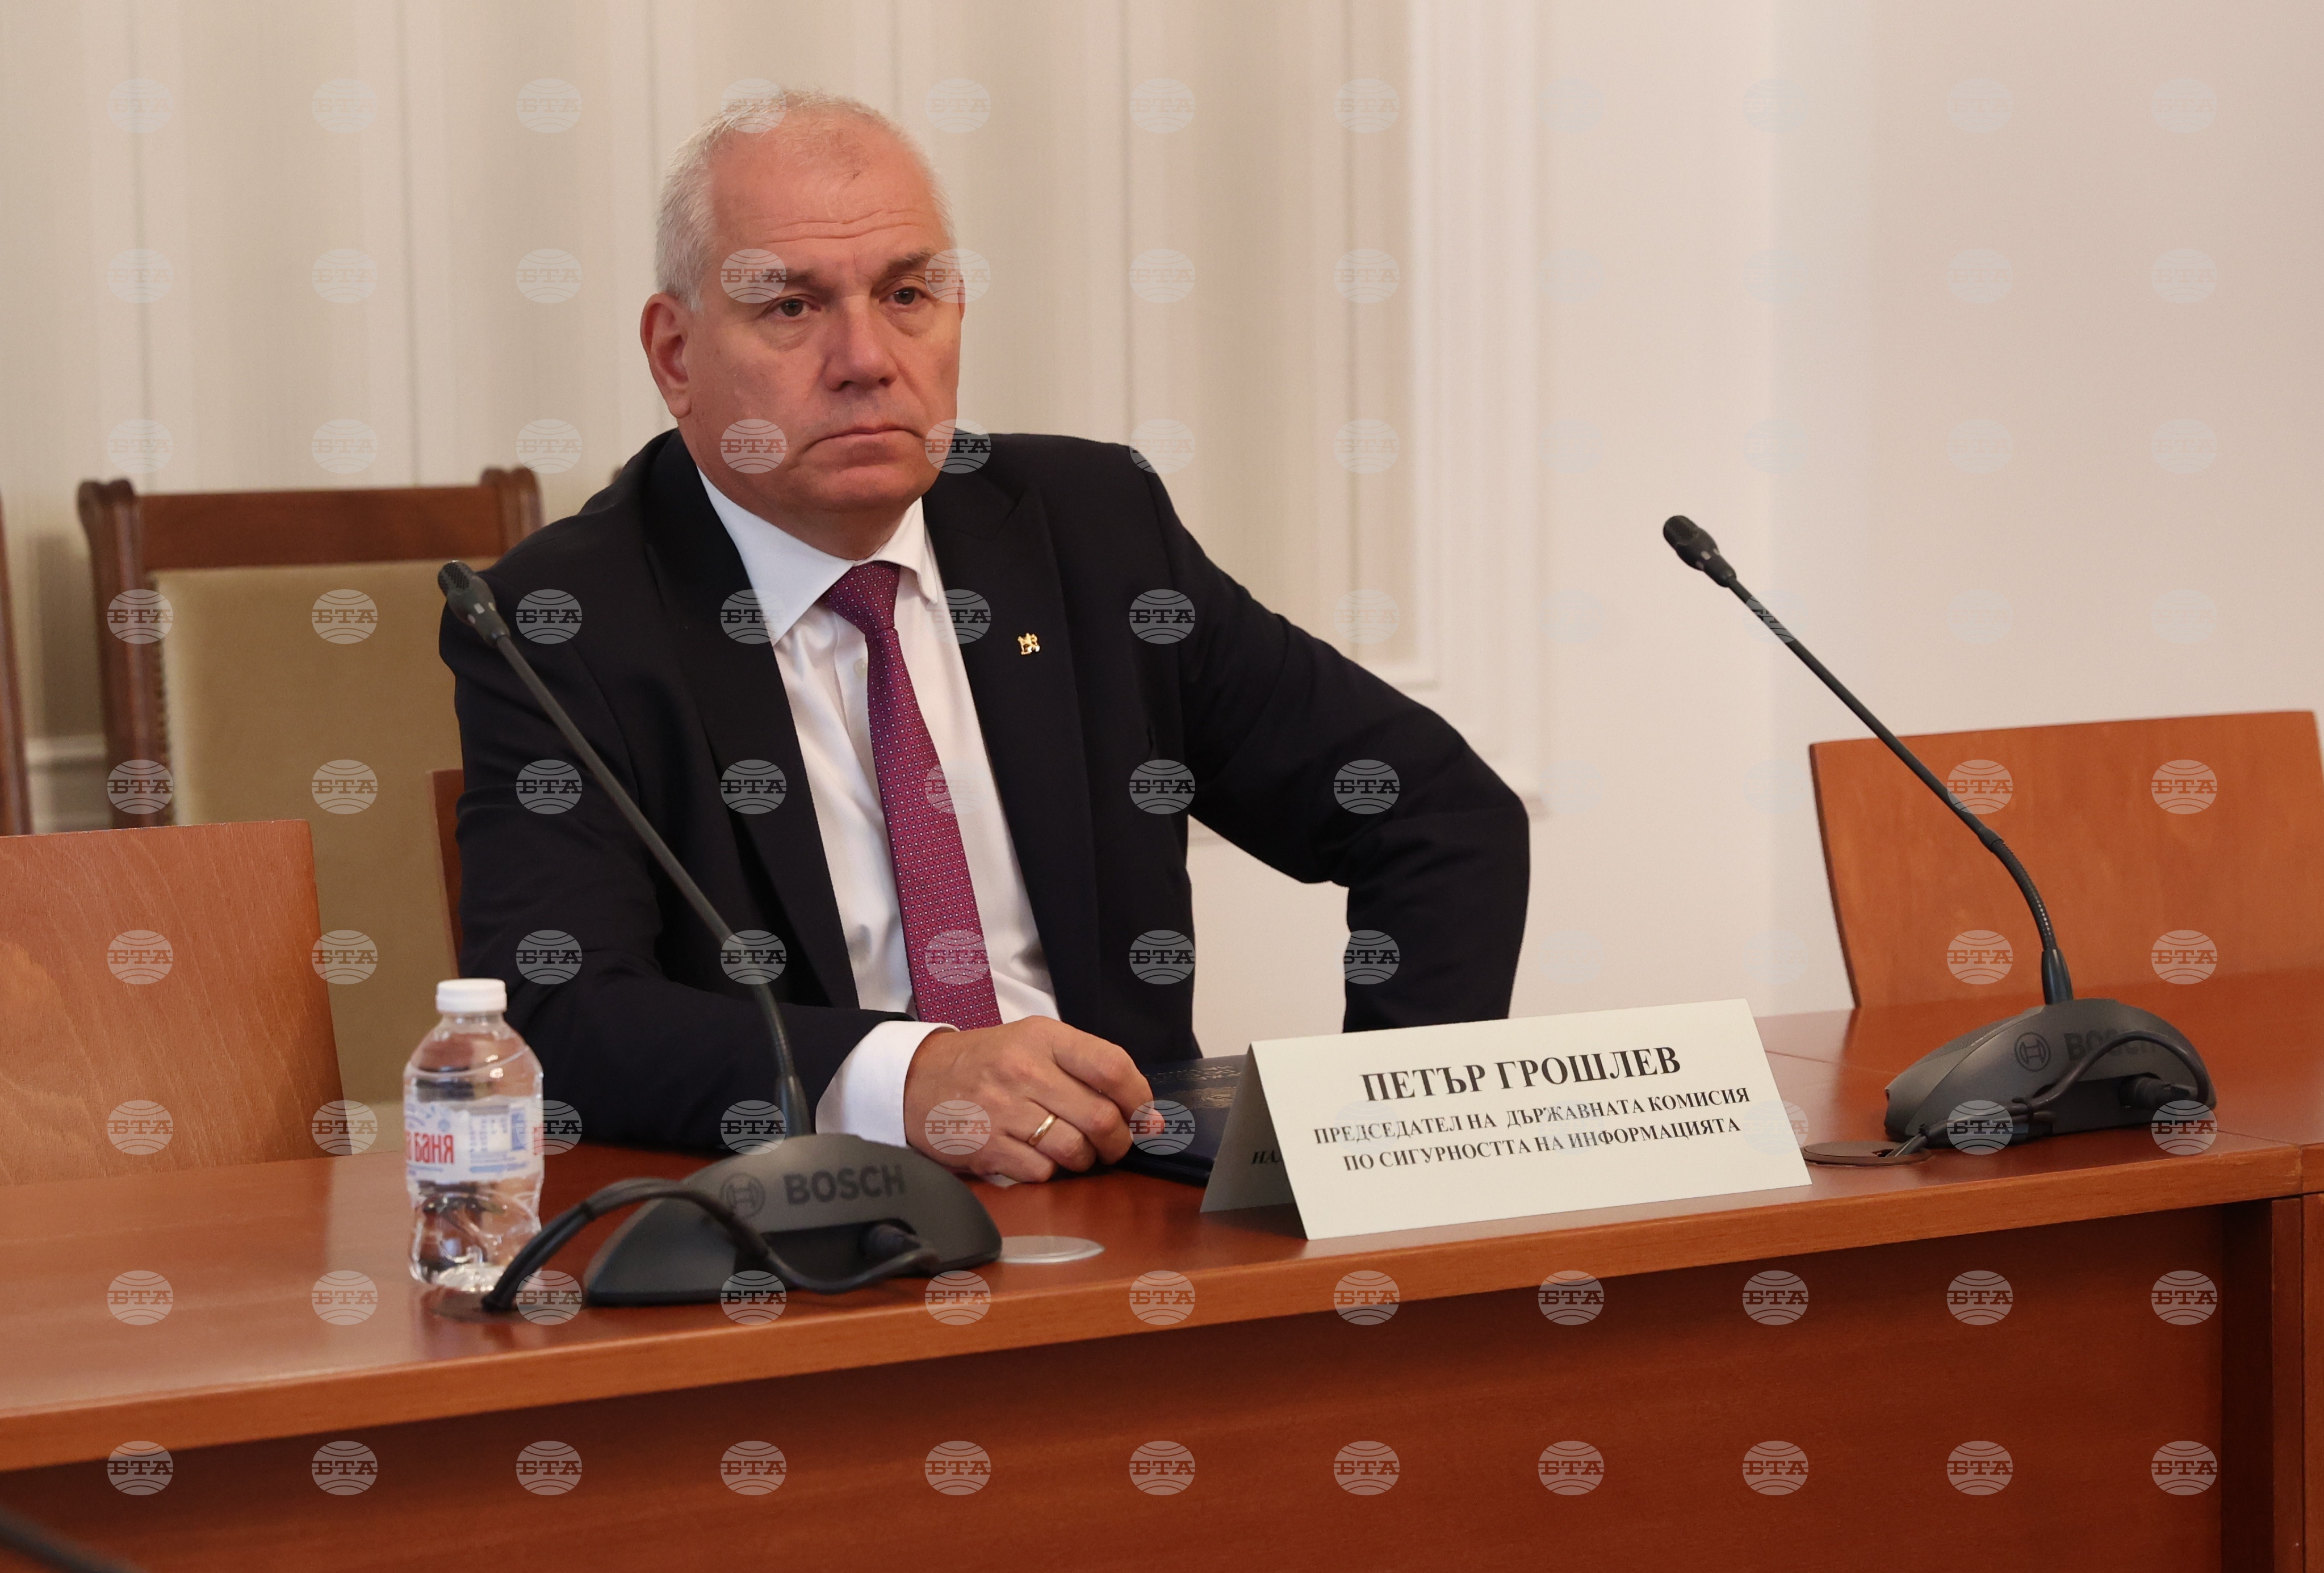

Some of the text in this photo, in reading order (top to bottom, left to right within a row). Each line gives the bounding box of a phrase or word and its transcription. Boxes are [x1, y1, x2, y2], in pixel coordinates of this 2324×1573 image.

[1359, 1047, 1681, 1101] ПЕТЪР ГРОШЛЕВ
[1313, 1116, 1462, 1144] ПРЕДСЕДАТЕЛ
[1467, 1113, 1497, 1130] НА
[1506, 1098, 1645, 1128] ДЪРЖАВНАТА
[1648, 1088, 1751, 1111] КОМИСИЯ
[1343, 1117, 1741, 1171] ПО СИГУРНОСТТА НА ИНФОРМАЦИЯТА
[783, 1164, 905, 1205] BOSCH
